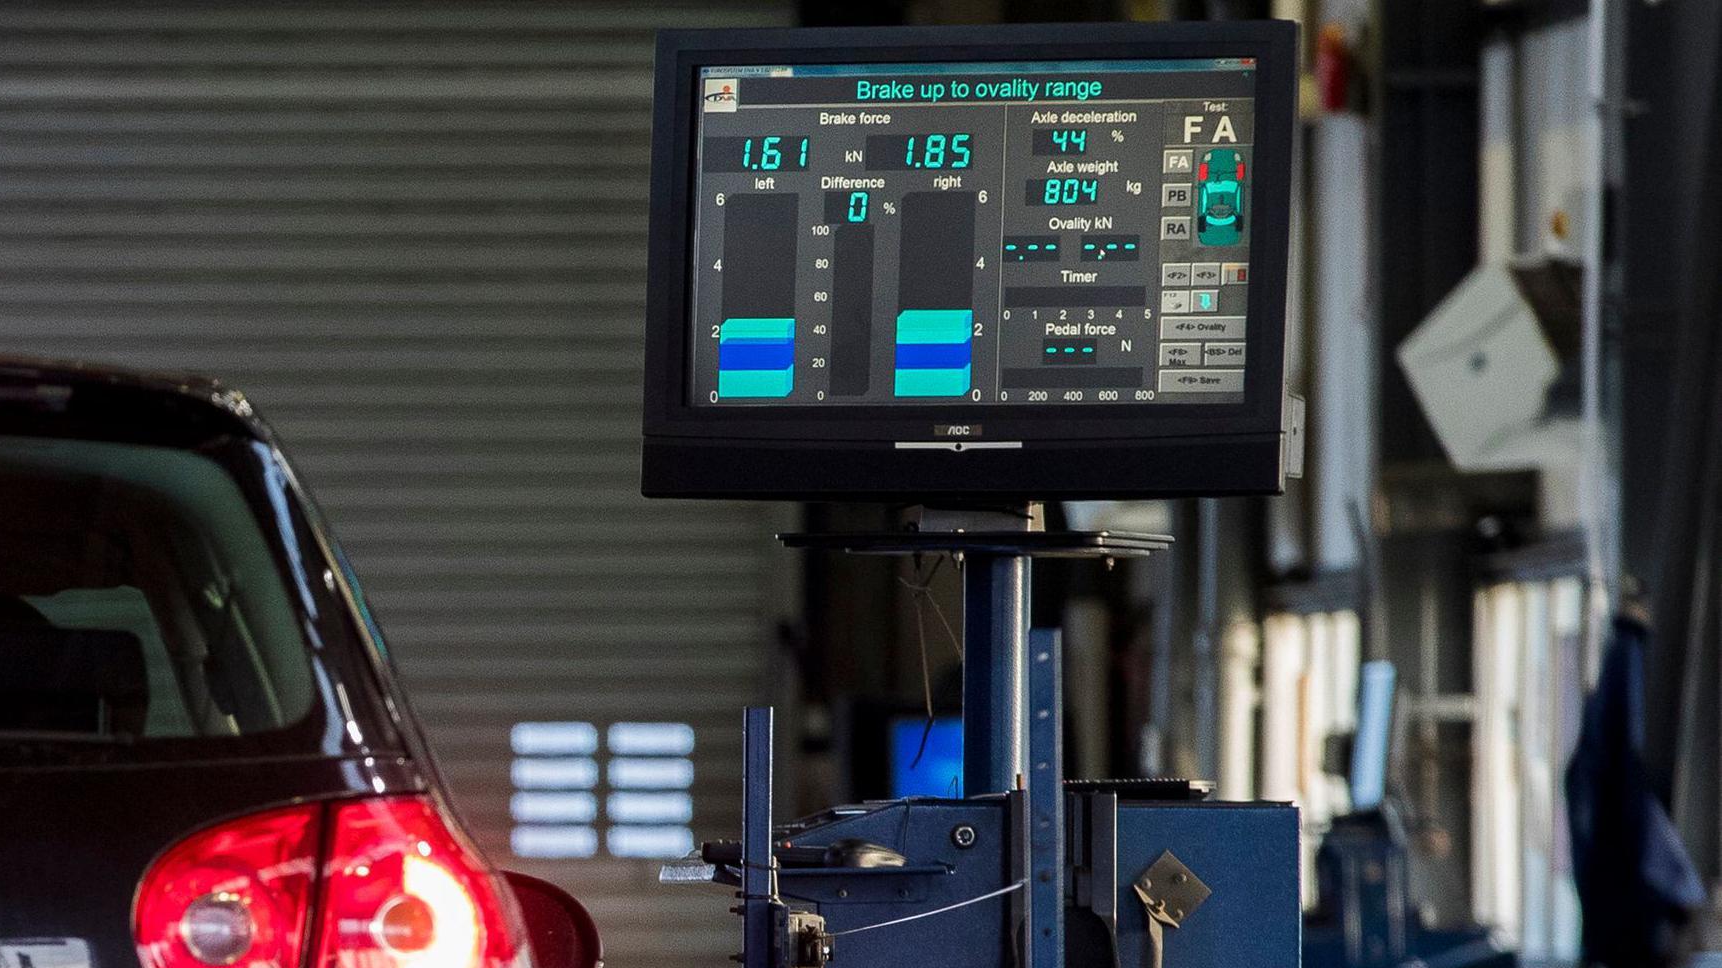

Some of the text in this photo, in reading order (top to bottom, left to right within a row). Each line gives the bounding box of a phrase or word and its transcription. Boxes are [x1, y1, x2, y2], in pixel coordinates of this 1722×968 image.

[856, 79, 1103, 102] Brake up to ovality range
[819, 112, 891, 125] Brake force
[1031, 111, 1137, 123] Axle deceleration
[1052, 130, 1125, 152] 44 %
[742, 136, 809, 170] 1.61
[844, 150, 863, 162] kN
[904, 134, 971, 168] 1.85
[1047, 160, 1119, 175] Axle weight
[1169, 156, 1190, 168] FA
[754, 178, 775, 190] left
[821, 177, 886, 189] Difference
[933, 176, 962, 190] right
[978, 190, 988, 203] 6
[1044, 178, 1142, 204] 804 kg
[1168, 190, 1187, 202] PB
[716, 193, 726, 206] 6
[847, 191, 896, 222] 0 %
[1048, 216, 1113, 231] Ovality kN
[1166, 223, 1187, 235] RA
[811, 225, 829, 236] 100
[713, 259, 722, 272] 4
[815, 258, 829, 269] 80
[976, 257, 985, 269] 4
[1061, 270, 1098, 283] Timer
[814, 291, 828, 302] 60
[1003, 308, 1152, 321] 0 1 2 3 4 5
[711, 326, 720, 338] 2
[813, 325, 827, 335] 40
[974, 323, 983, 336] 2
[1045, 322, 1117, 336] Pedal force
[1197, 322, 1227, 332] Ovality
[1121, 340, 1132, 352] N
[1228, 347, 1243, 356] Del
[812, 358, 826, 368] 20
[1199, 376, 1221, 384] Save
[710, 390, 719, 403] 0
[816, 390, 825, 401] 0
[972, 389, 981, 402] 0
[1000, 390, 1155, 402] 0 200 400 600 800
